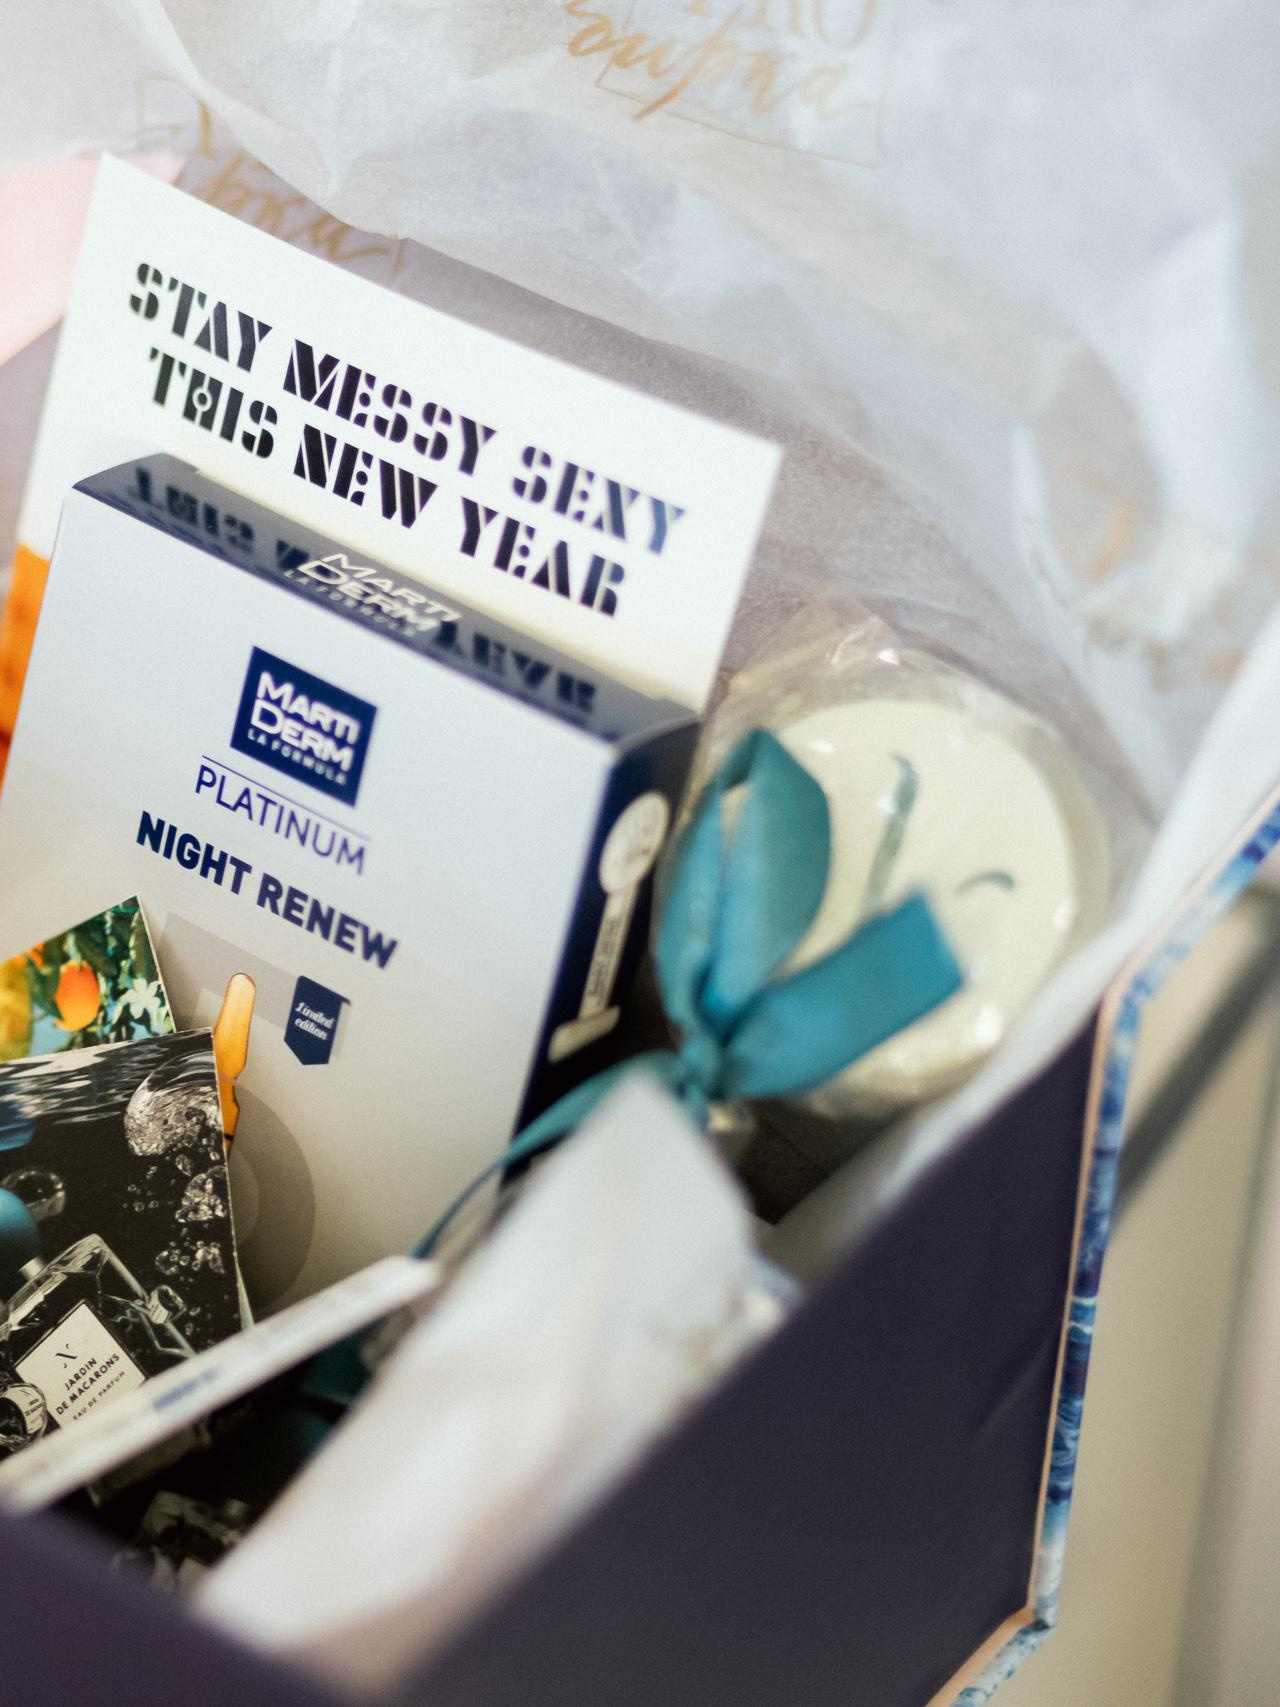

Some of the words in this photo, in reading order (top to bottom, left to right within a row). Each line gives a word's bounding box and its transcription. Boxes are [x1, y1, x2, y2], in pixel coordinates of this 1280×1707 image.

[129, 262, 273, 373] STAY
[283, 338, 498, 477] MESSY
[512, 445, 686, 555] SEXY
[150, 347, 279, 459] THIS
[293, 424, 438, 529] NEW
[460, 496, 627, 618] YEAR
[322, 553, 462, 622] MARTI
[247, 728, 267, 746] LA
[250, 699, 352, 772] DERM
[257, 671, 360, 744] MARTI
[195, 764, 365, 876] PLATINUM
[136, 811, 252, 895] NIGHT
[256, 873, 397, 970] RENEW
[56, 1401, 69, 1415] DE
[69, 1353, 120, 1404] MACARONS
[65, 1357, 97, 1391] JARDIN
[73, 1407, 87, 1421] EAU
[88, 1397, 98, 1407] DE
[98, 1370, 125, 1396] PARFUM
